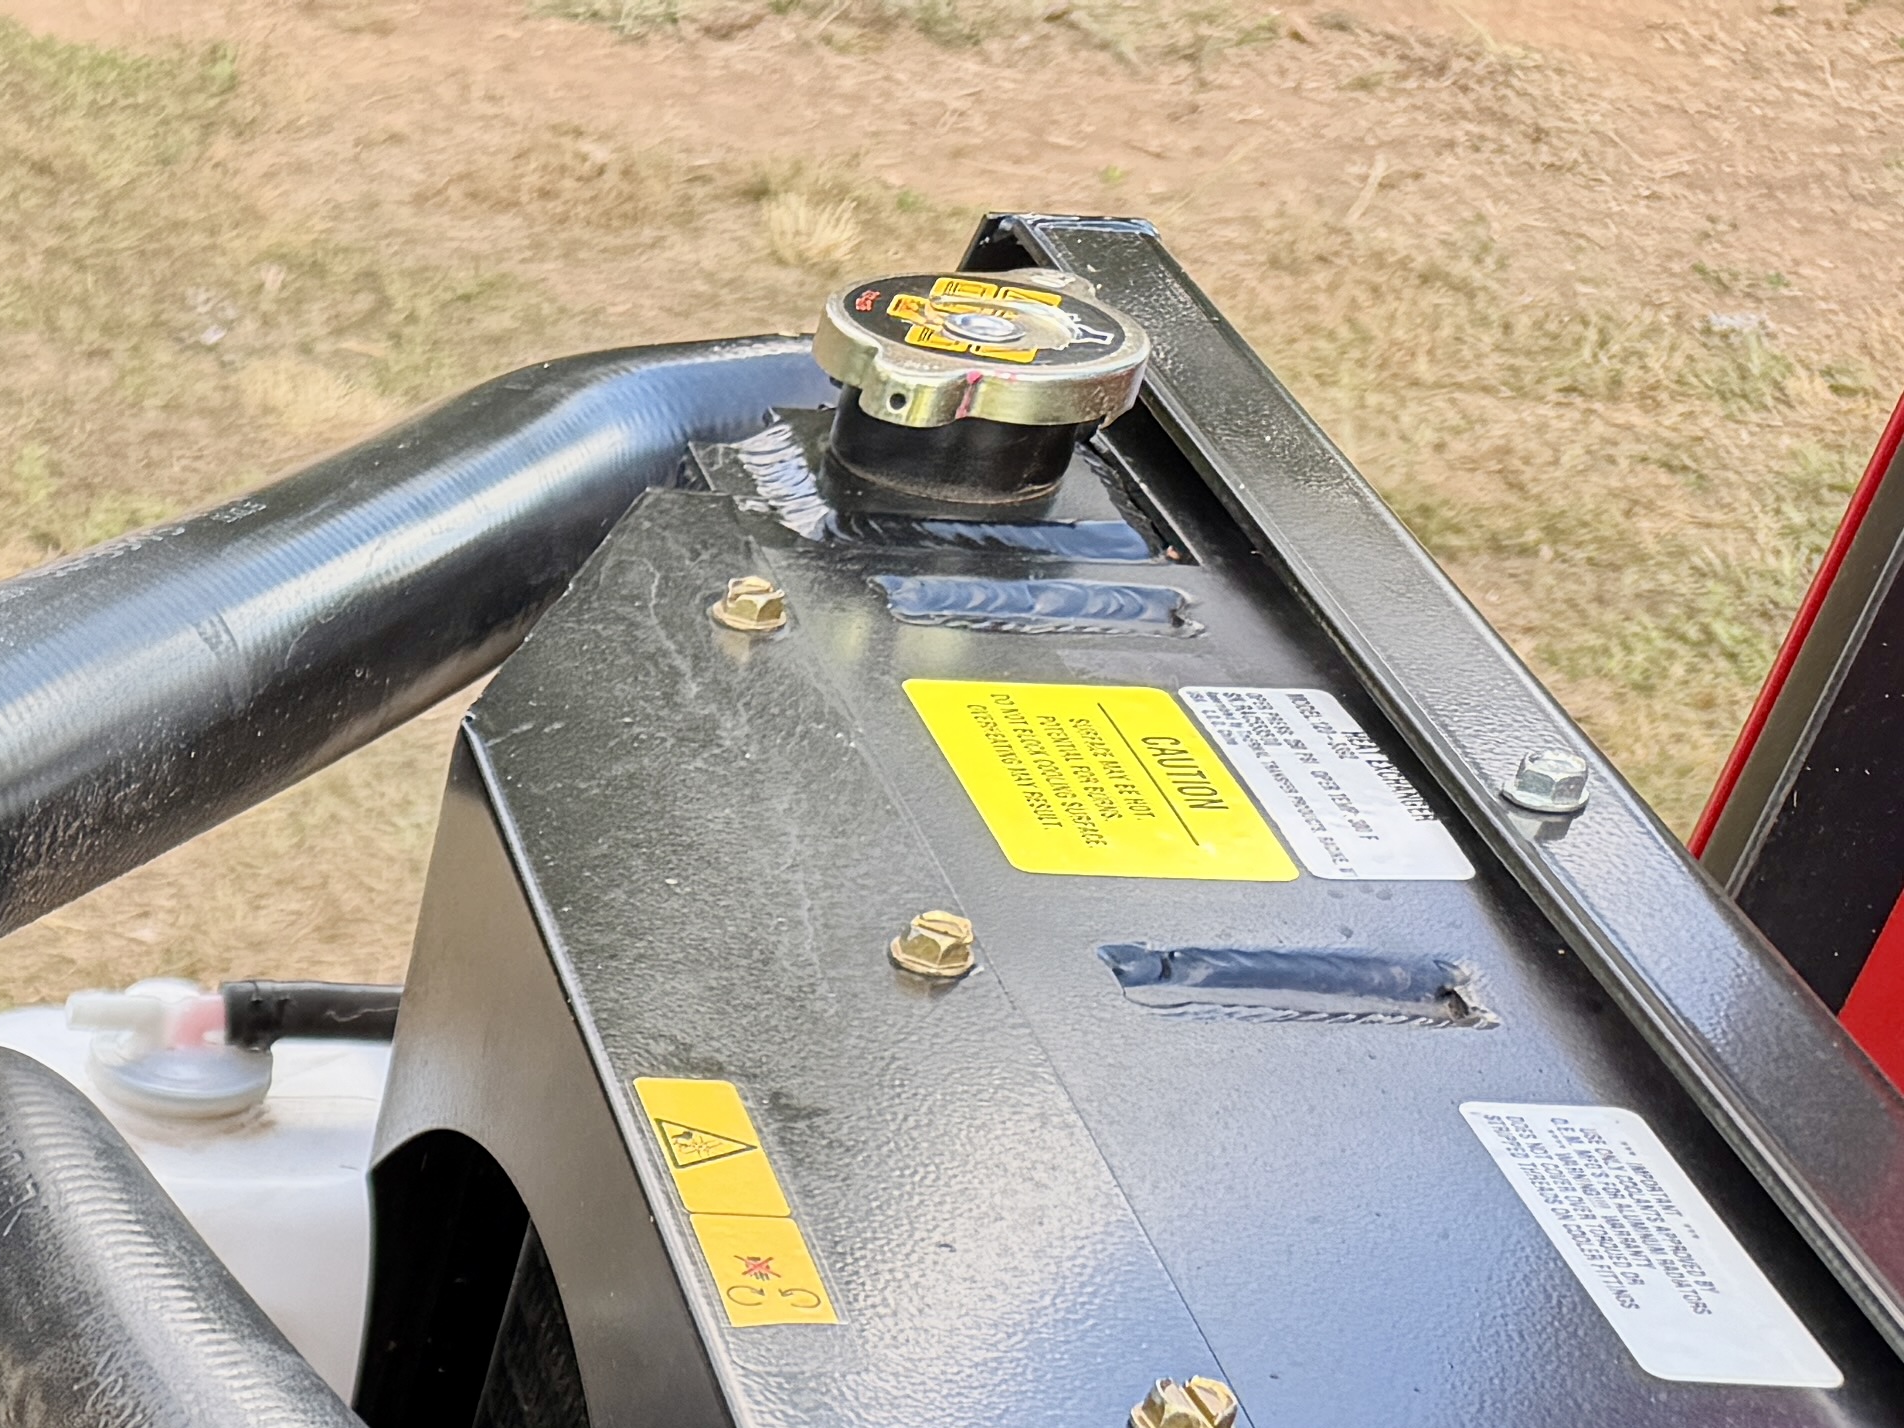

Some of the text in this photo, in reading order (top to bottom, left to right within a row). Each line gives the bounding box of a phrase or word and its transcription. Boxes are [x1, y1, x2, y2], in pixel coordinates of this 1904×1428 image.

[964, 704, 1066, 830] OVERHEATING MAY RESULT.
[988, 693, 1111, 849] DO NOT BLOCK COOLING SURFACE.
[1034, 716, 1126, 821] POTENTIAL FOR BURNS.
[1067, 718, 1159, 820] SURFACE MAY BE HOT.
[1137, 735, 1230, 810] CAUTION
[1340, 731, 1433, 821] HEAT EXCHANGER
[1481, 1115, 1641, 1309] STRIPPED THREADS ON COOLER FITTINGS
[1504, 1116, 1647, 1285] DOES NOT COVER OVER TORQUED OR
[1577, 1128, 1720, 1293] USE ONLY COOLANTS APPROVED BY
[1599, 1215, 1657, 1269] WARRANTY
[1625, 1162, 1684, 1217] IMPORTANT
[1596, 1181, 1627, 1199] FOR
[1612, 1202, 1668, 1255] ALUMINUM
[1654, 1258, 1714, 1315] RADIATORS
